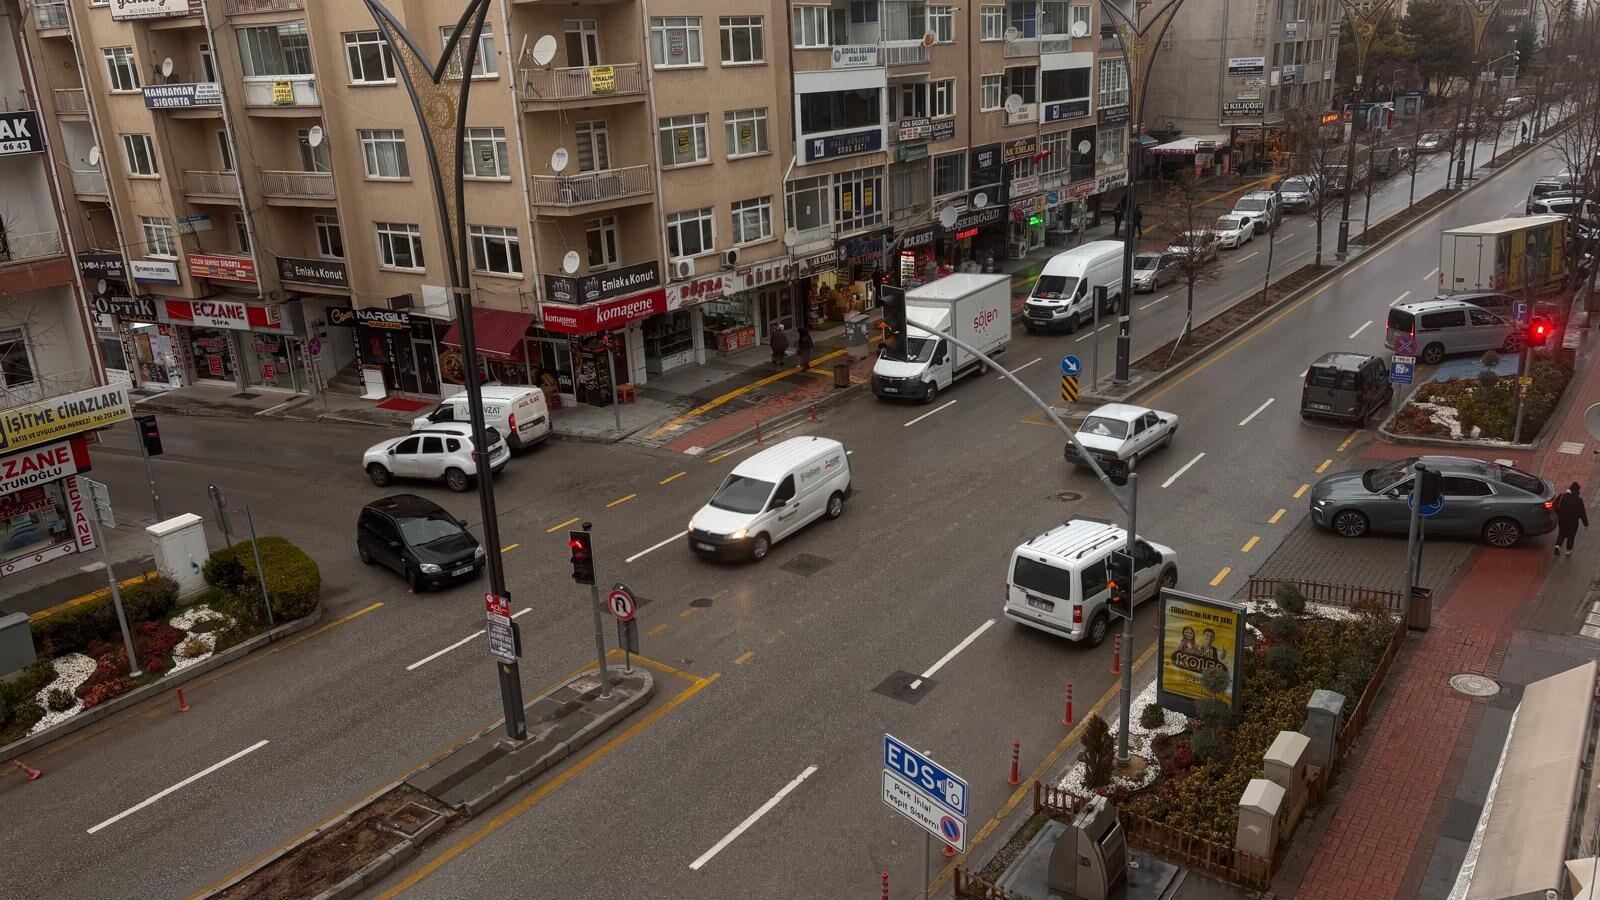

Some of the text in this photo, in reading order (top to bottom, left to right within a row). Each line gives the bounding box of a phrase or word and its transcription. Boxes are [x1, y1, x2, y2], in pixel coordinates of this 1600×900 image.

[144, 86, 194, 97] KAHRAMAN
[3, 142, 28, 151] 66 43
[1015, 144, 1035, 154] EMLAK
[903, 231, 934, 249] MARKET
[192, 302, 245, 320] ECZANE
[545, 313, 577, 326] komagene
[596, 298, 653, 323] komagene
[5, 390, 122, 435] İŞİTME CİHAZLARI
[11, 434, 28, 444] SATIŞ
[36, 424, 67, 437] UYGULAMA
[67, 417, 91, 429] MERKEZİ
[0, 446, 70, 480] ZANE
[66, 476, 92, 546] ECZANE
[888, 742, 935, 790] EDS
[894, 783, 911, 800] Park
[885, 789, 939, 831] Tespit Sistemi
